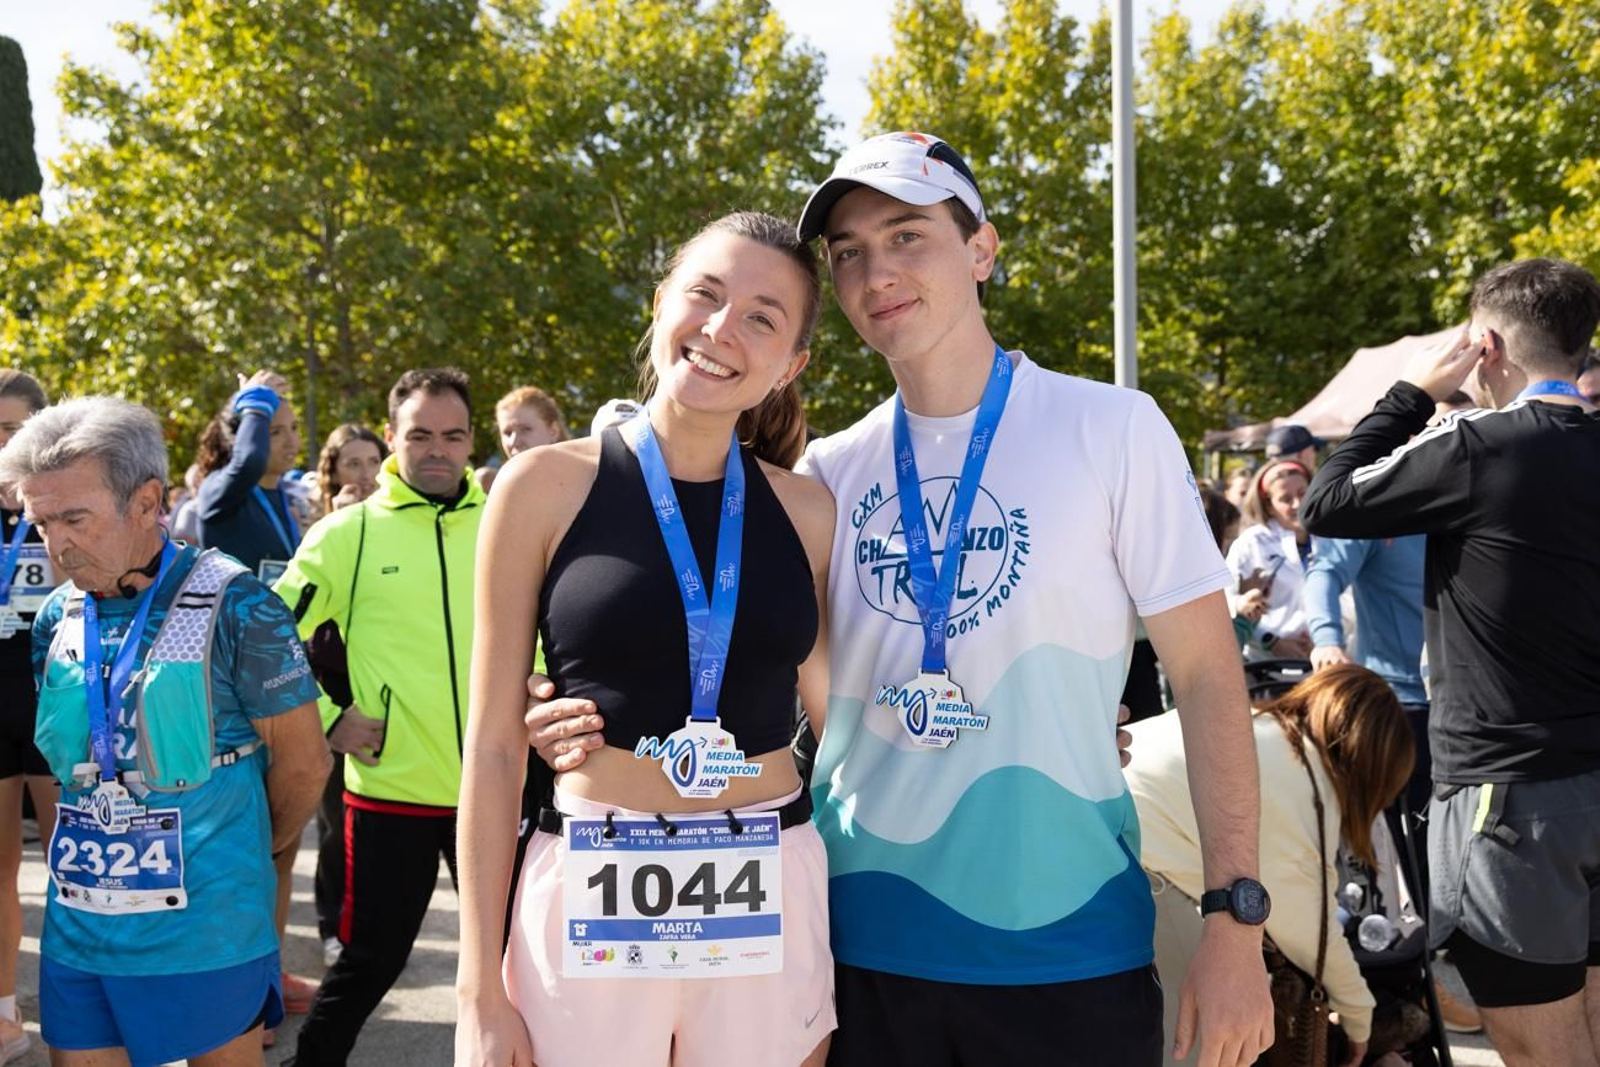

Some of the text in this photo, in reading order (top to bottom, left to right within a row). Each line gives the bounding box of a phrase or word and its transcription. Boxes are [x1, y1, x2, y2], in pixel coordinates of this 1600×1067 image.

[852, 482, 883, 529] CXM
[986, 507, 1031, 617] MONTAÑA
[935, 702, 970, 713] MEDIA
[932, 715, 986, 728] MARATÓN
[928, 727, 955, 738] JAÉN
[706, 751, 744, 761] MEDIA
[702, 763, 760, 775] MARATÓN
[697, 776, 727, 788] JAÉN
[667, 837, 698, 845] MEMORIA
[702, 836, 711, 844] DE
[714, 836, 732, 844] PACO
[735, 834, 774, 842] MANZANEDA
[57, 836, 173, 877] 2324
[587, 859, 767, 917] 1044
[651, 921, 704, 934] MARTA
